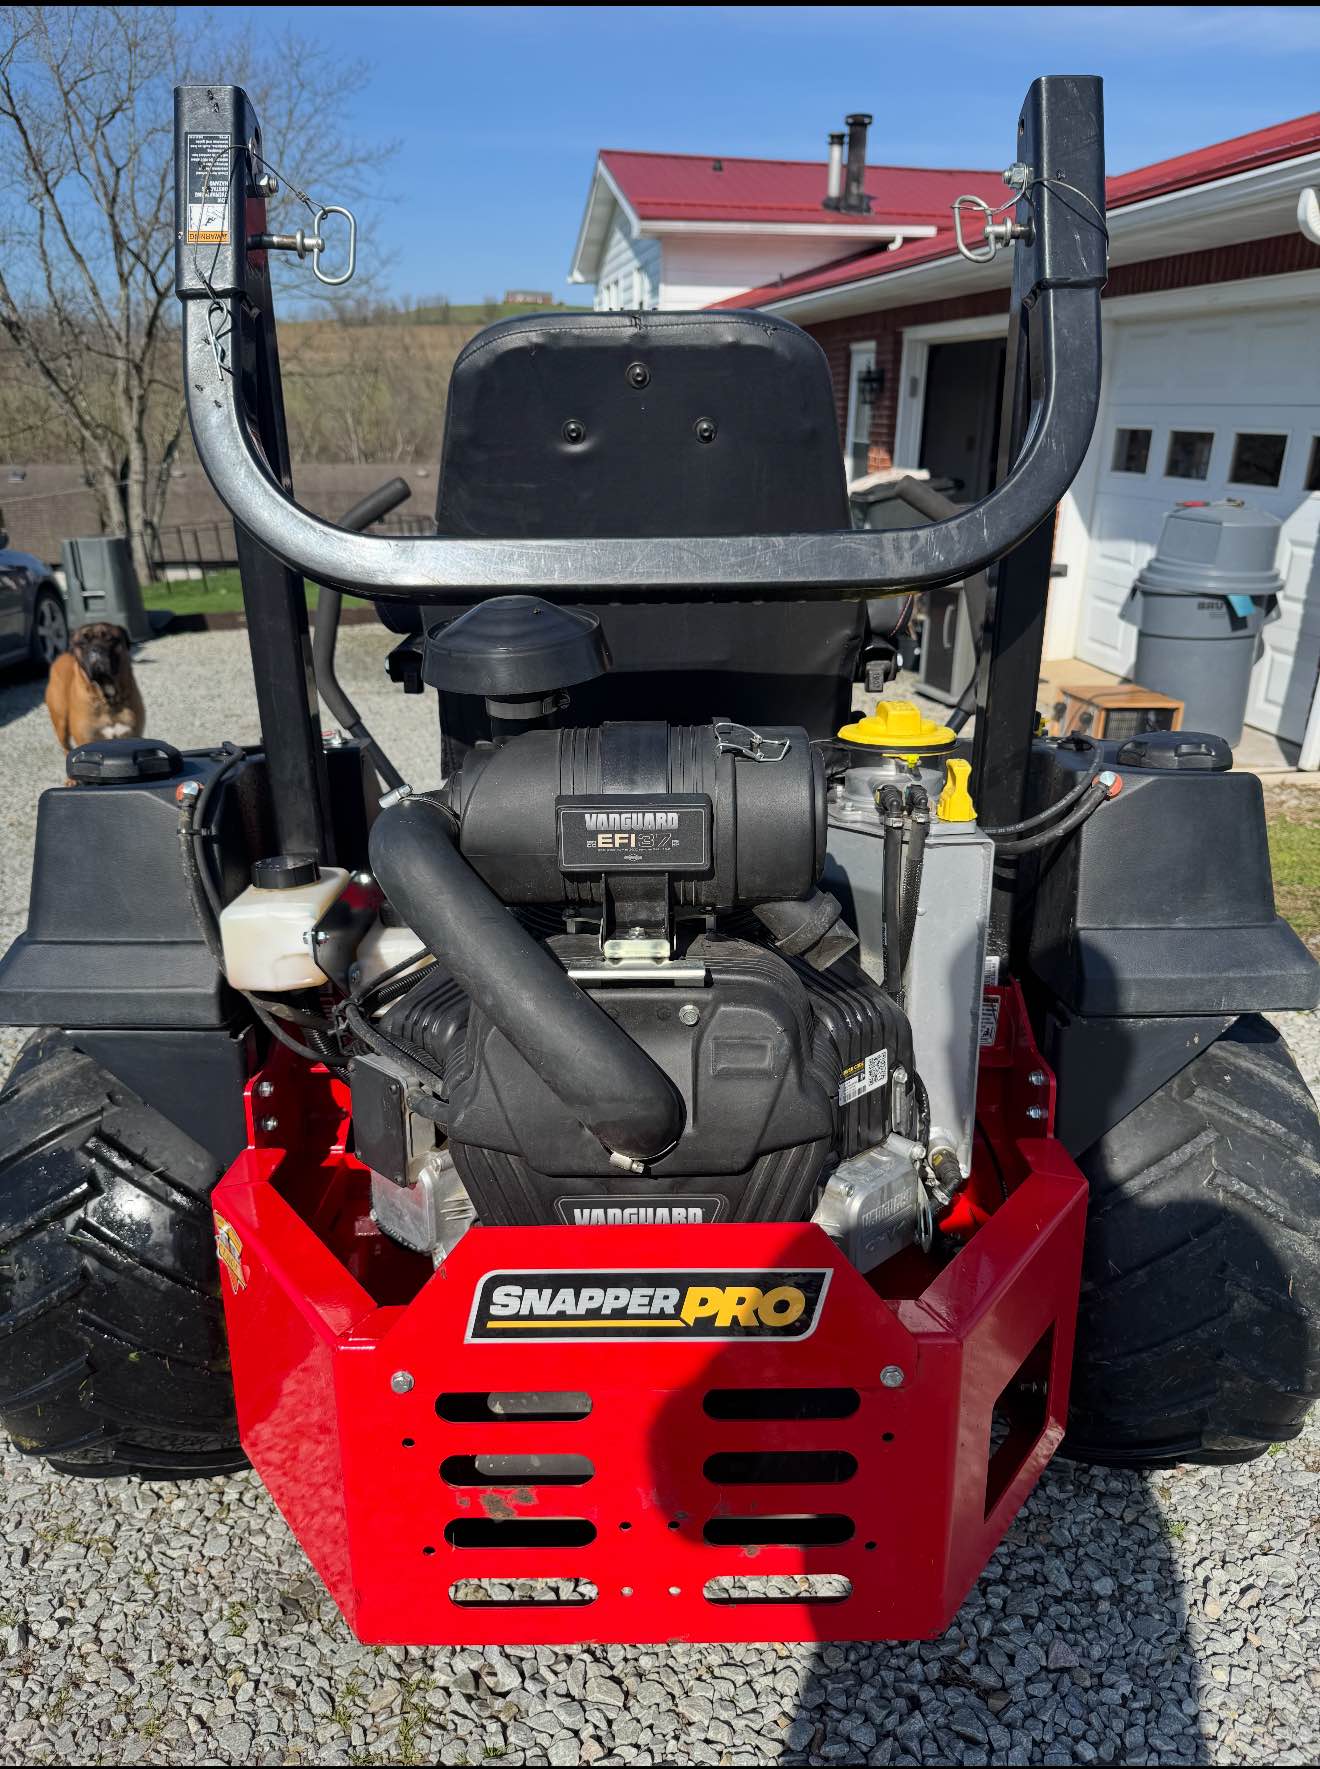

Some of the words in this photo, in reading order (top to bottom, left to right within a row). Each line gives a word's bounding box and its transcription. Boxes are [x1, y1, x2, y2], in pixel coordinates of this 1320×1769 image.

[1198, 601, 1225, 610] BRU
[585, 812, 679, 831] VANGUARD
[573, 1207, 703, 1225] VANGUARD
[489, 1285, 681, 1316] SNAPPER
[680, 1286, 806, 1327] PRO
